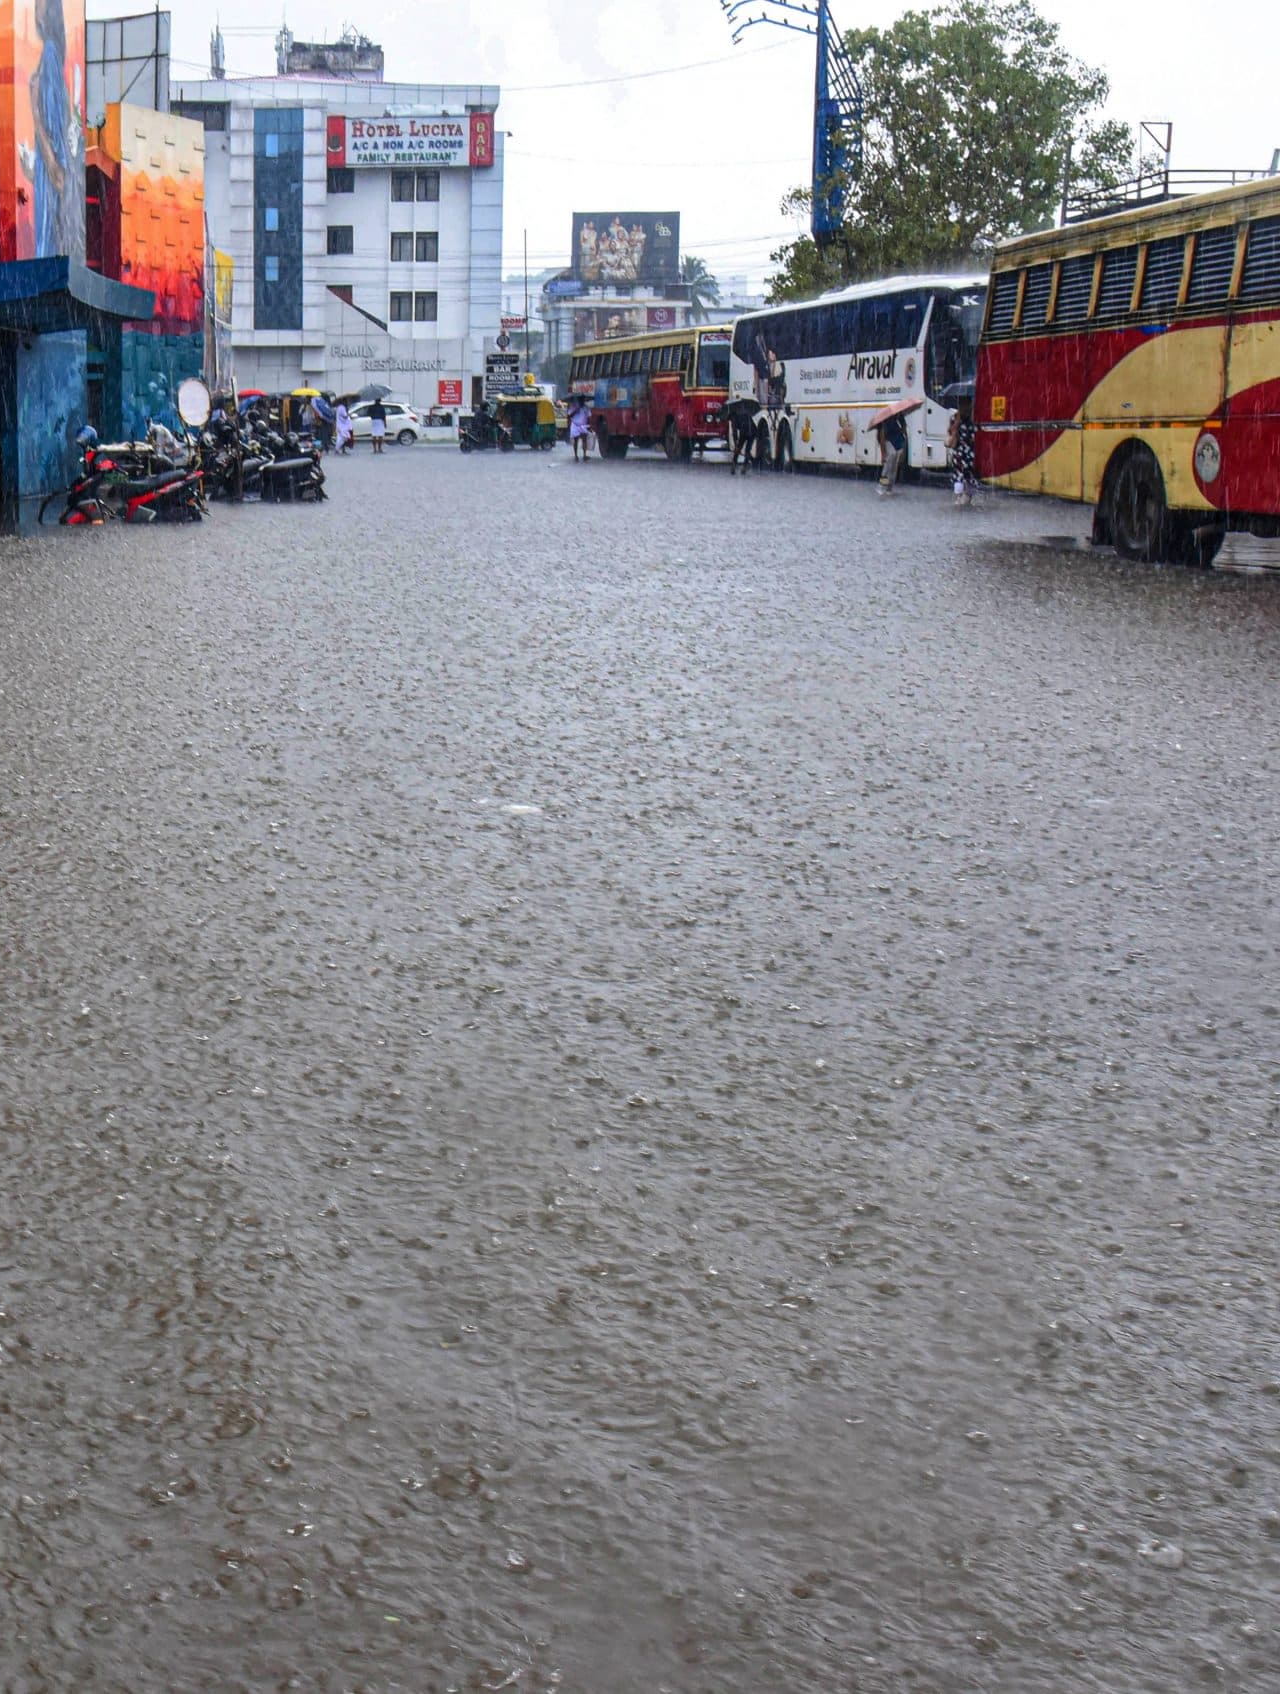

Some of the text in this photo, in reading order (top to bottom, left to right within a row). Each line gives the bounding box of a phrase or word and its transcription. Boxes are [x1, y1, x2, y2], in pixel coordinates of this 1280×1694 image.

[352, 120, 463, 138] HOTEL LUCIYA
[383, 141, 403, 150] NON
[428, 140, 463, 149] ROOMS
[475, 122, 486, 157] BAR
[357, 152, 457, 163] FAMILY RESTAURANT
[961, 295, 980, 306] K
[331, 345, 377, 359] FAMILY
[362, 359, 448, 372] RESTAURANT
